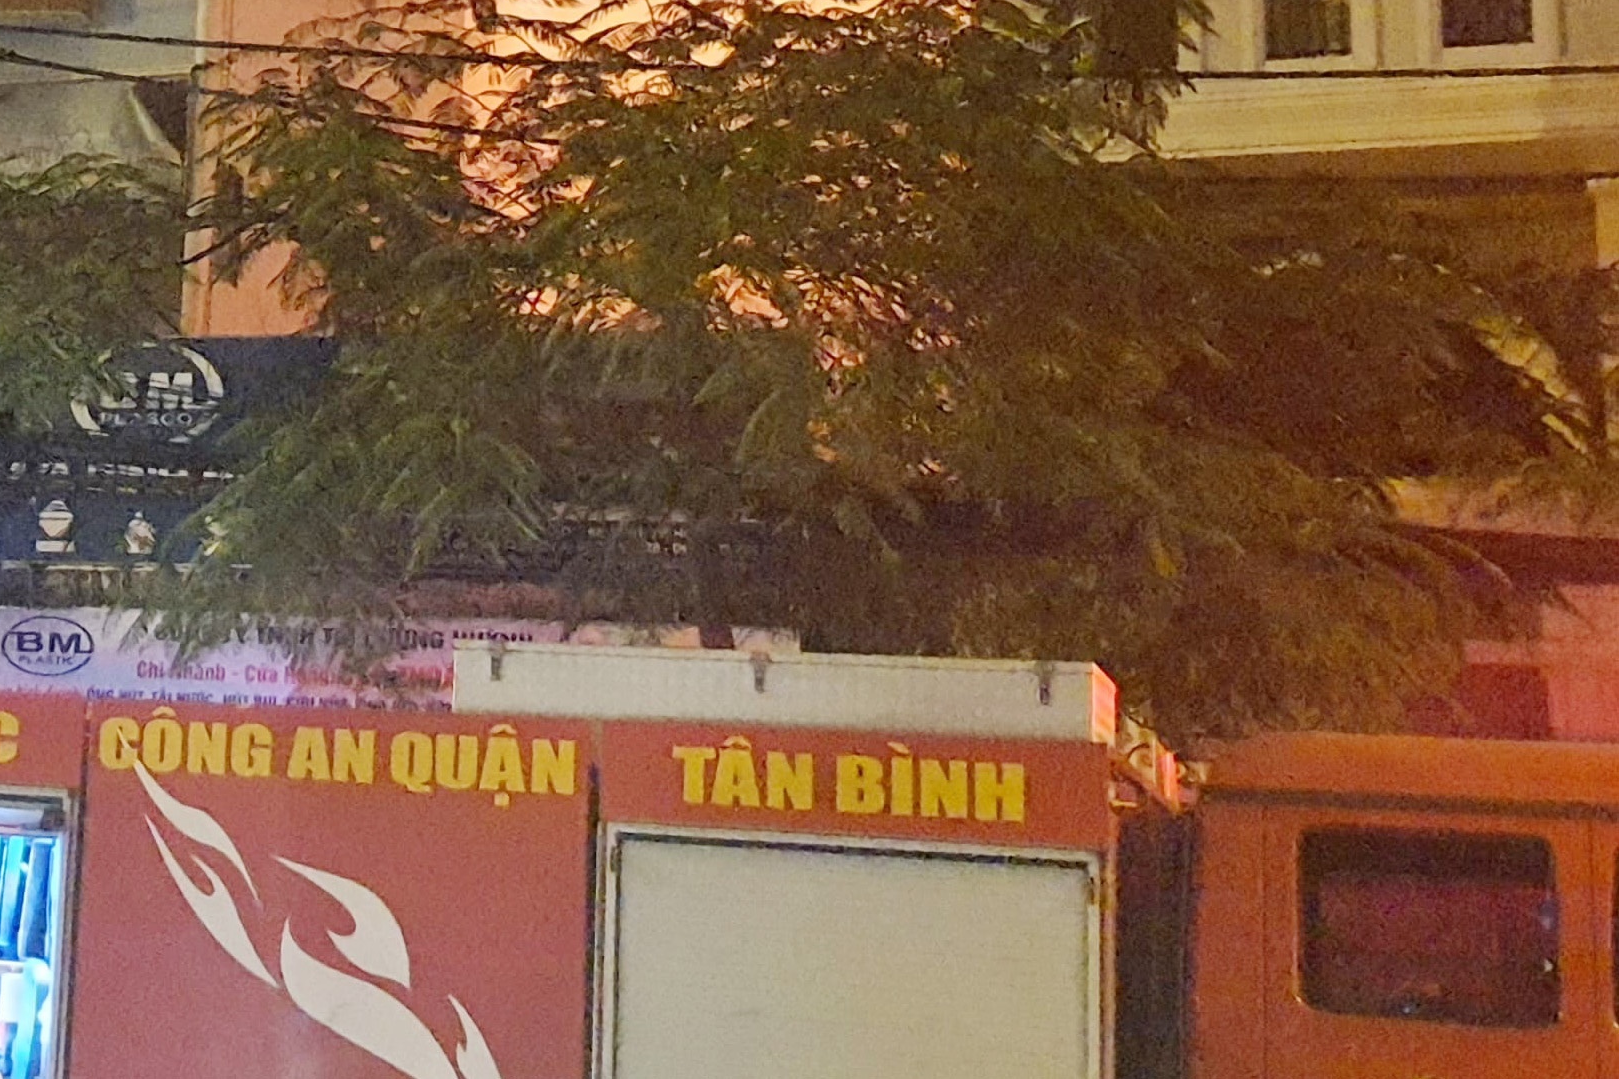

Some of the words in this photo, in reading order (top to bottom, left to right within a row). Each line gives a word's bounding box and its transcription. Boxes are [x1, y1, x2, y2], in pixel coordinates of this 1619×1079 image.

[12, 631, 95, 654] BM
[136, 660, 163, 681] Chi
[99, 706, 273, 778] CÔNG
[287, 726, 378, 784] AN
[390, 723, 577, 809] QUẬN
[672, 735, 814, 810] TÂN
[835, 741, 1026, 822] BÌNH
